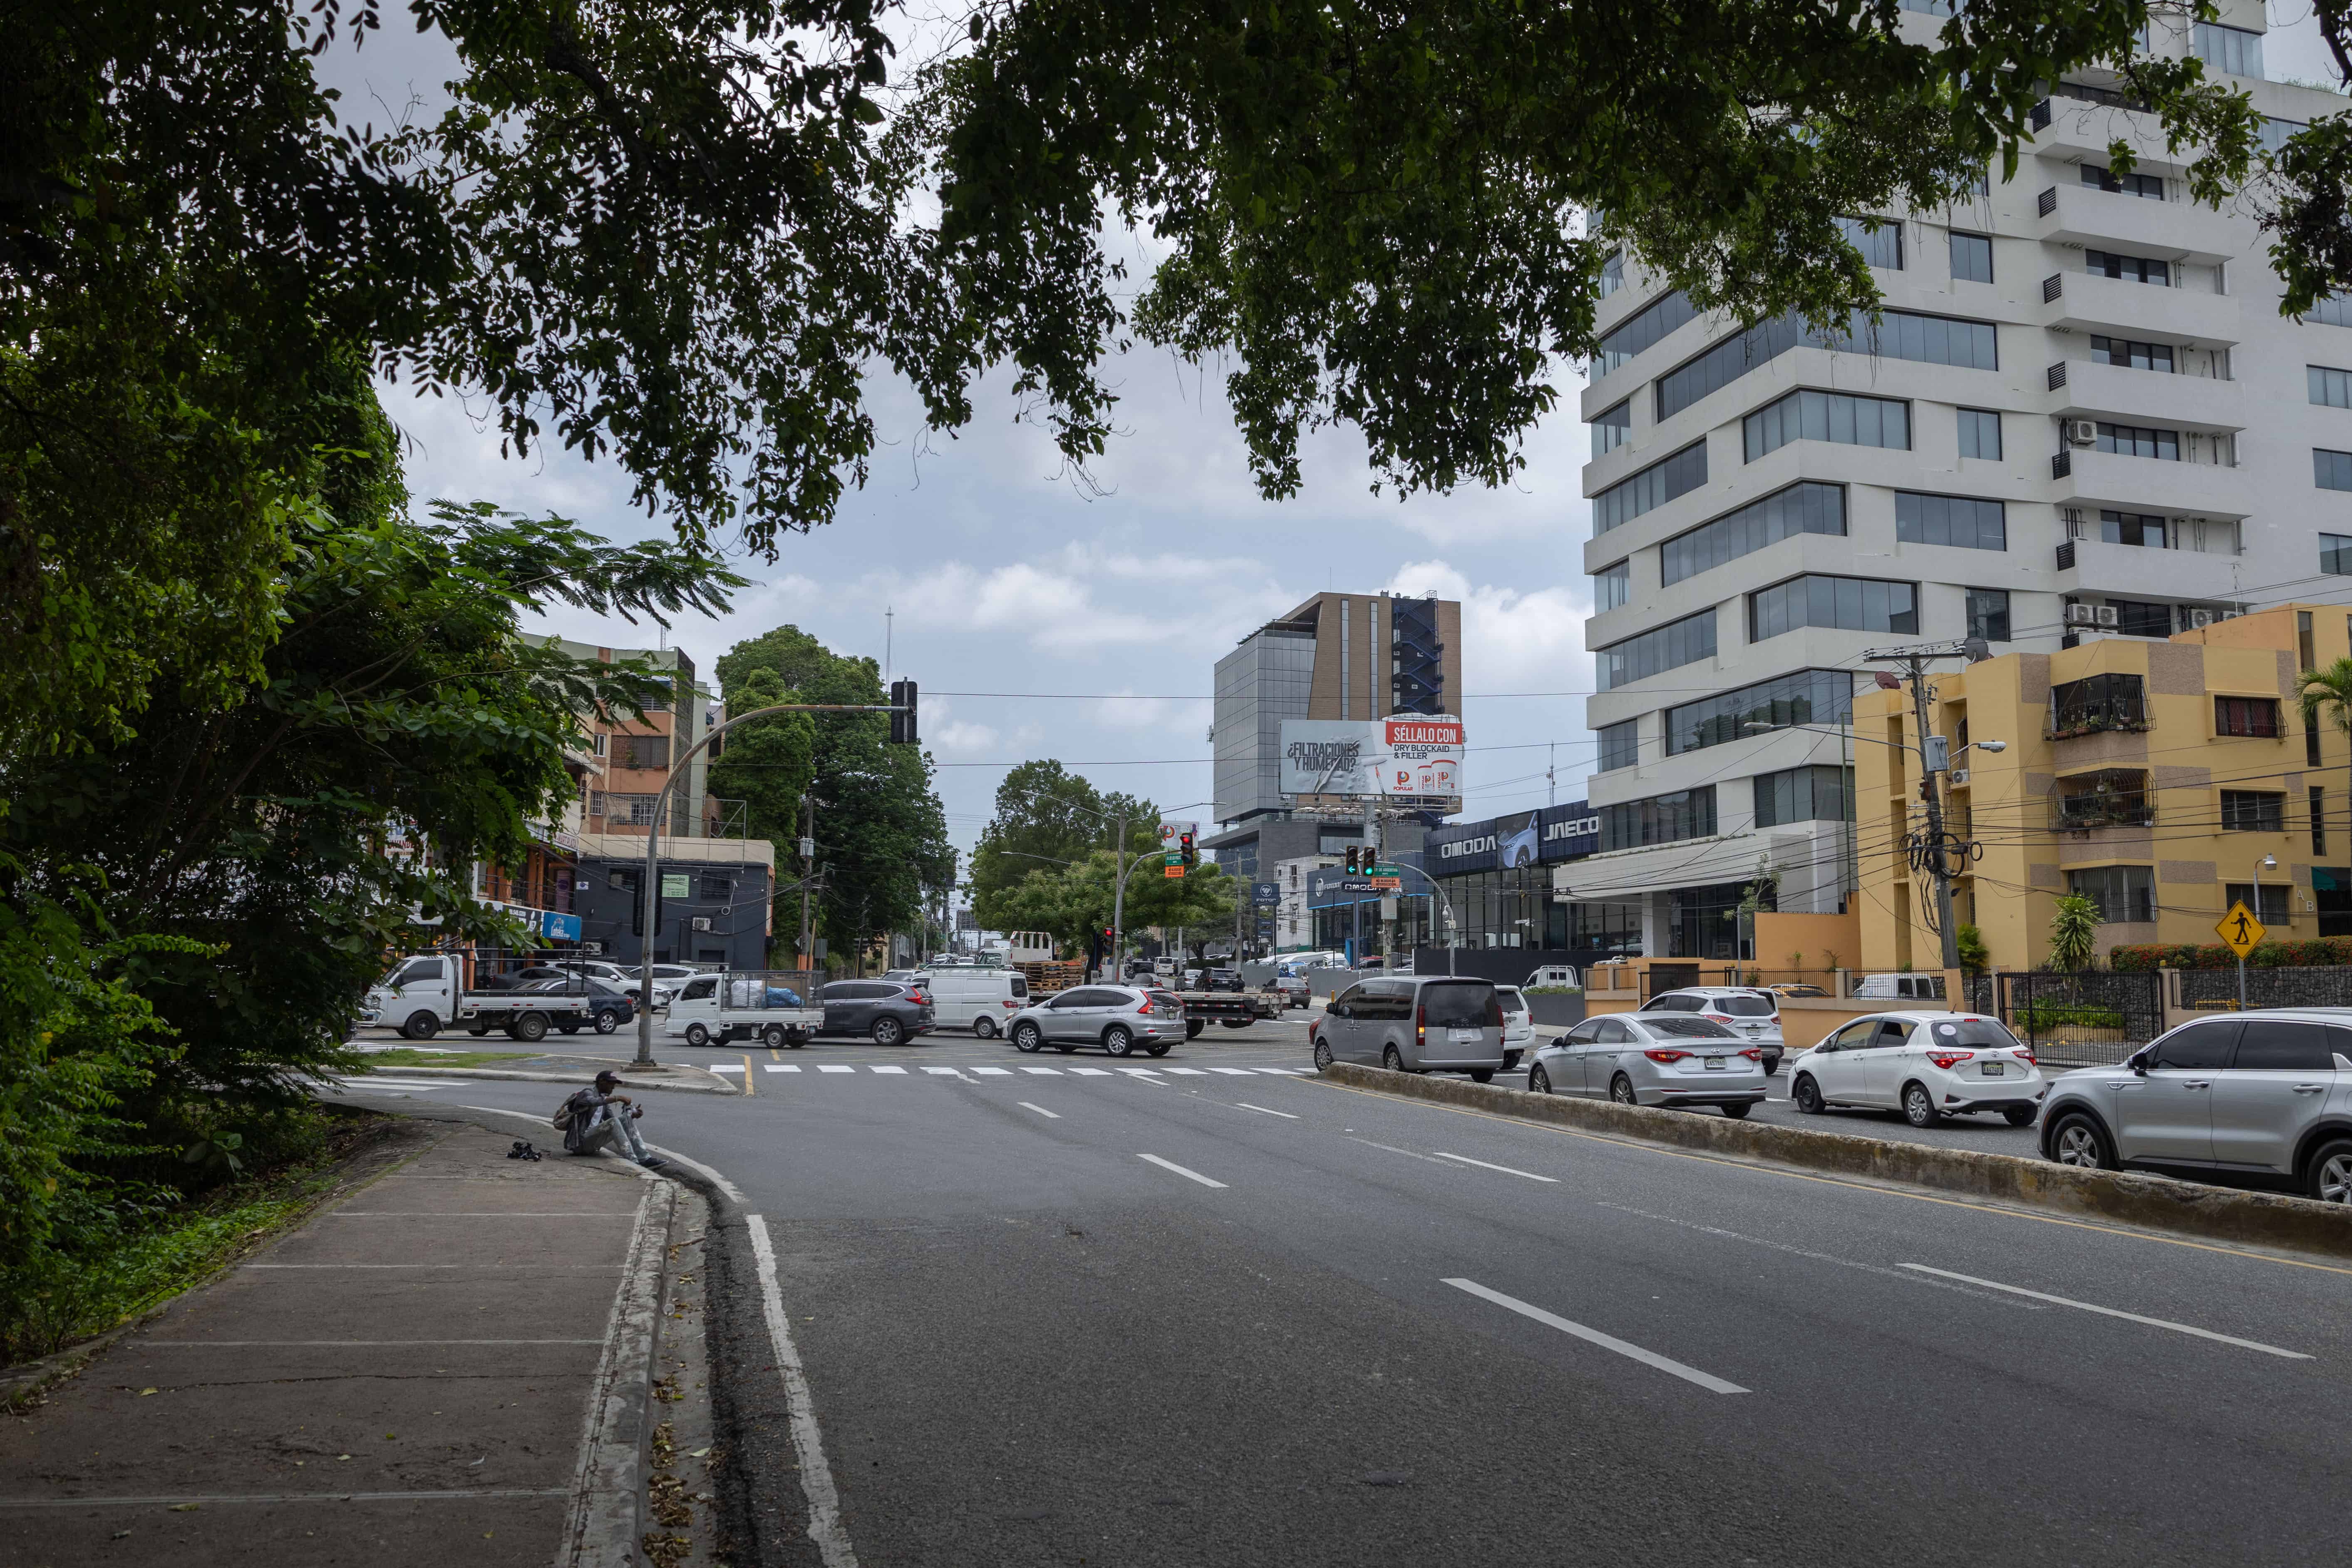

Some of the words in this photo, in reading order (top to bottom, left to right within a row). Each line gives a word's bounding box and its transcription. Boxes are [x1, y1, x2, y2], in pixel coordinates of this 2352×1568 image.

[1394, 724, 1435, 742] SÉLLALO
[1437, 728, 1456, 743] CON
[1288, 742, 1359, 757] ¿FILTRACIONES
[1294, 757, 1301, 770] Y
[1441, 835, 1496, 859] OMODA
[2297, 889, 2304, 901] A
[2307, 901, 2314, 912] B
